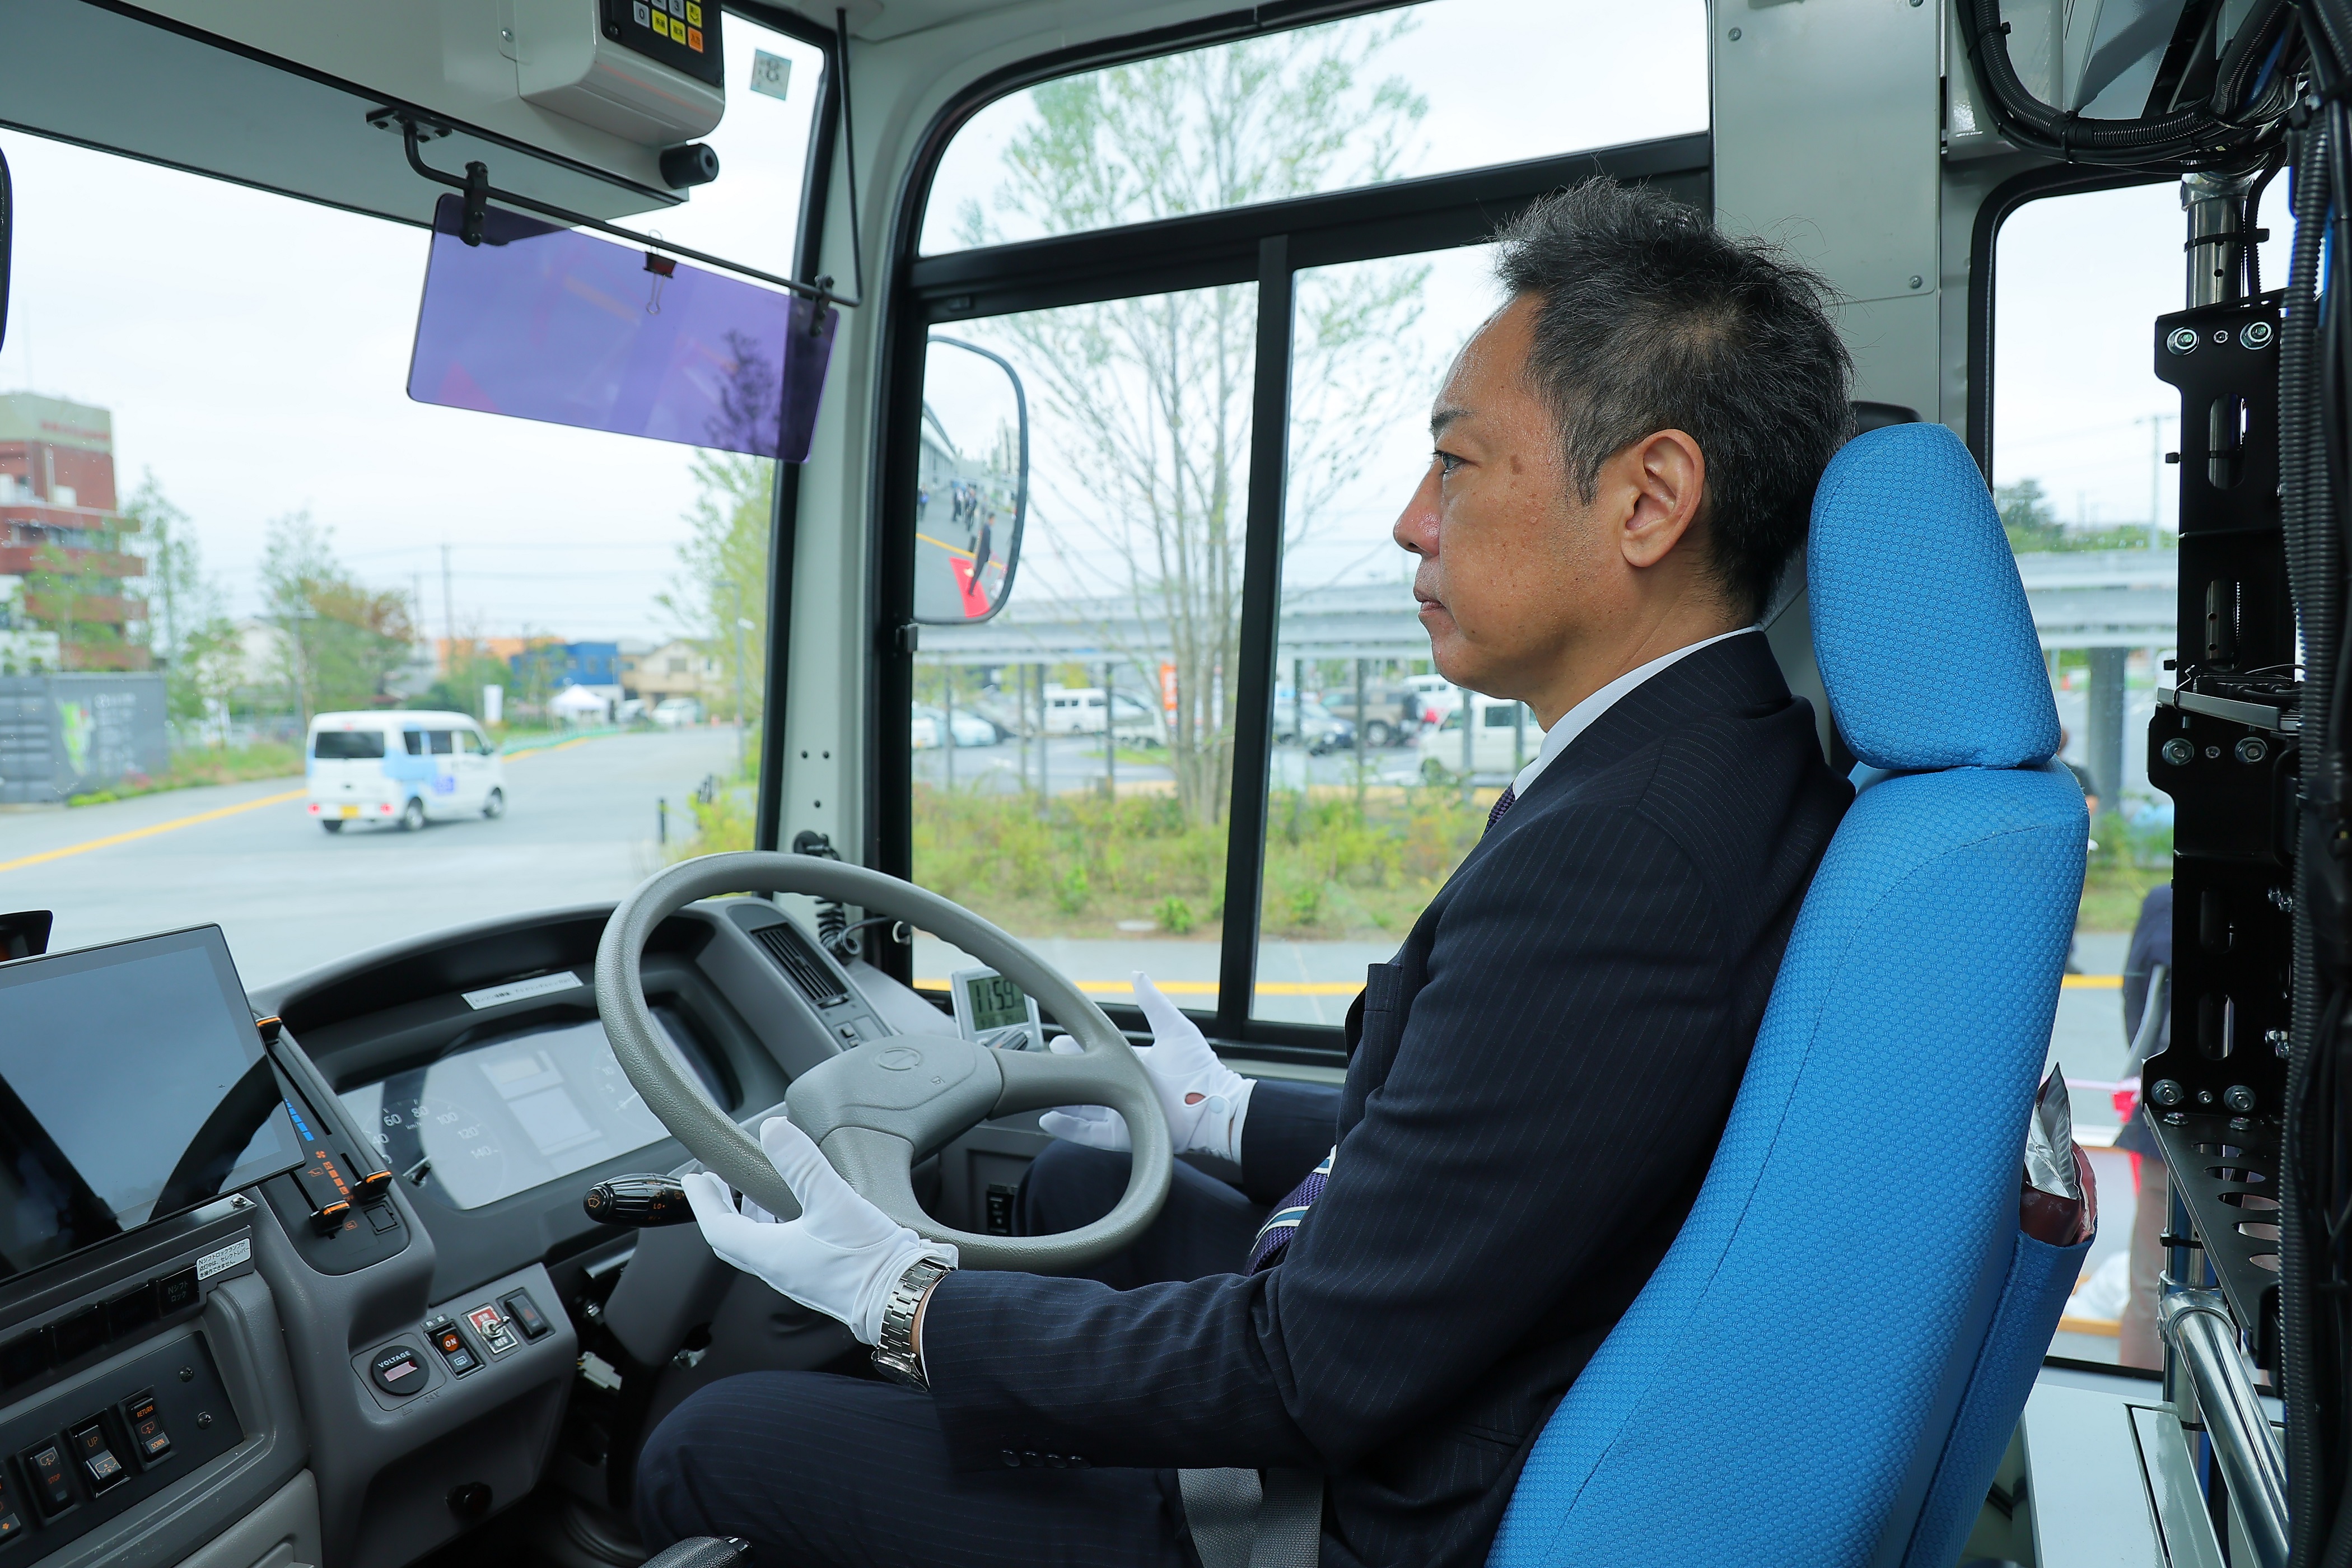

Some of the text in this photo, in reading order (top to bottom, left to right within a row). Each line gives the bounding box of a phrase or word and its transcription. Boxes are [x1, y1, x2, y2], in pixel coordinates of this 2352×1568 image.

[638, 8, 645, 20] 0
[411, 1105, 429, 1118] 80
[383, 1113, 403, 1127] 60
[436, 1112, 459, 1126] 100
[457, 1126, 479, 1140] 120
[470, 1145, 492, 1159] 140
[199, 1241, 245, 1265] Nシフトロックランプが
[168, 1280, 188, 1295] Nシフト
[171, 1291, 186, 1303] ロック
[445, 1337, 458, 1347] ON
[494, 1336, 510, 1347] OFF
[377, 1350, 412, 1368] VOLTAGE
[137, 1404, 153, 1418] RETURN
[87, 1436, 99, 1448] UP
[151, 1438, 165, 1450] DOWN
[48, 1473, 61, 1485] STOP
